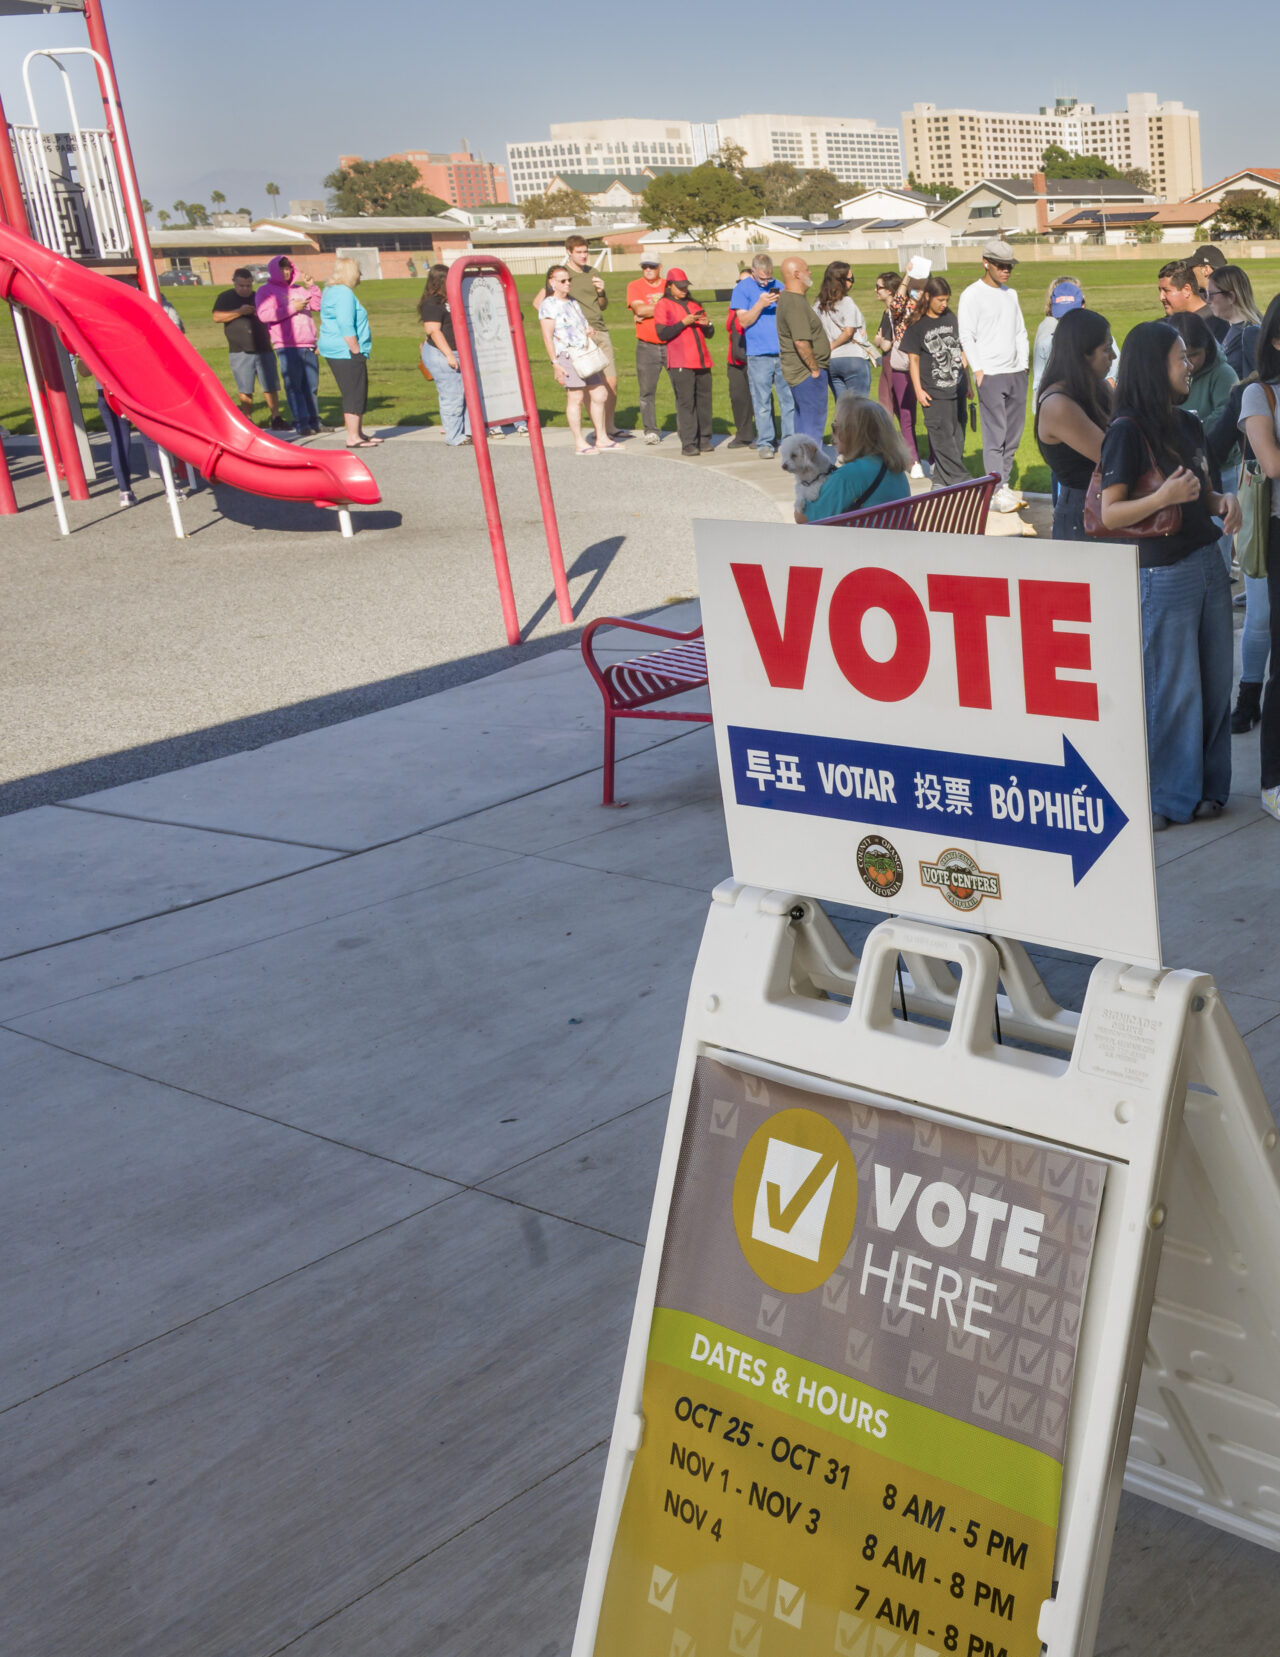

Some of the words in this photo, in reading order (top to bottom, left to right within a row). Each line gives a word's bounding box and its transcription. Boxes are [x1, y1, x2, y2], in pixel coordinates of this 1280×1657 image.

[729, 562, 1099, 721] VOTE
[746, 749, 805, 792] 투표
[817, 761, 897, 803] VOTAR
[914, 772, 973, 816] 投票
[990, 775, 1024, 823] BỎ
[1028, 784, 1104, 834] PHIẾU
[863, 875, 901, 896] CALIFORNIA
[922, 867, 950, 885] VOTE
[951, 872, 998, 893] CENTERS
[874, 1163, 1045, 1277] VOTE
[860, 1242, 998, 1339] HERE
[690, 1332, 767, 1387] DATES
[772, 1367, 790, 1398] &
[796, 1376, 889, 1439] HOURS
[675, 1396, 722, 1433] OCT
[723, 1416, 754, 1447] 25
[771, 1436, 821, 1476] OCT
[824, 1458, 850, 1490] 31
[664, 1488, 708, 1531] NOV
[710, 1517, 723, 1542] 4
[669, 1441, 714, 1483] NOV
[720, 1468, 729, 1493] 1
[748, 1481, 802, 1524] NOV
[805, 1507, 821, 1535] 3
[882, 1483, 897, 1510] 8
[902, 1494, 946, 1533] AM
[963, 1519, 981, 1548] 5
[986, 1529, 1029, 1570] PM
[862, 1534, 878, 1561] 8
[882, 1545, 927, 1584] AM
[950, 1571, 965, 1599] 8
[974, 1580, 1015, 1621] PM
[854, 1584, 870, 1611] 7
[875, 1596, 920, 1636] AM
[944, 1624, 959, 1652] 8
